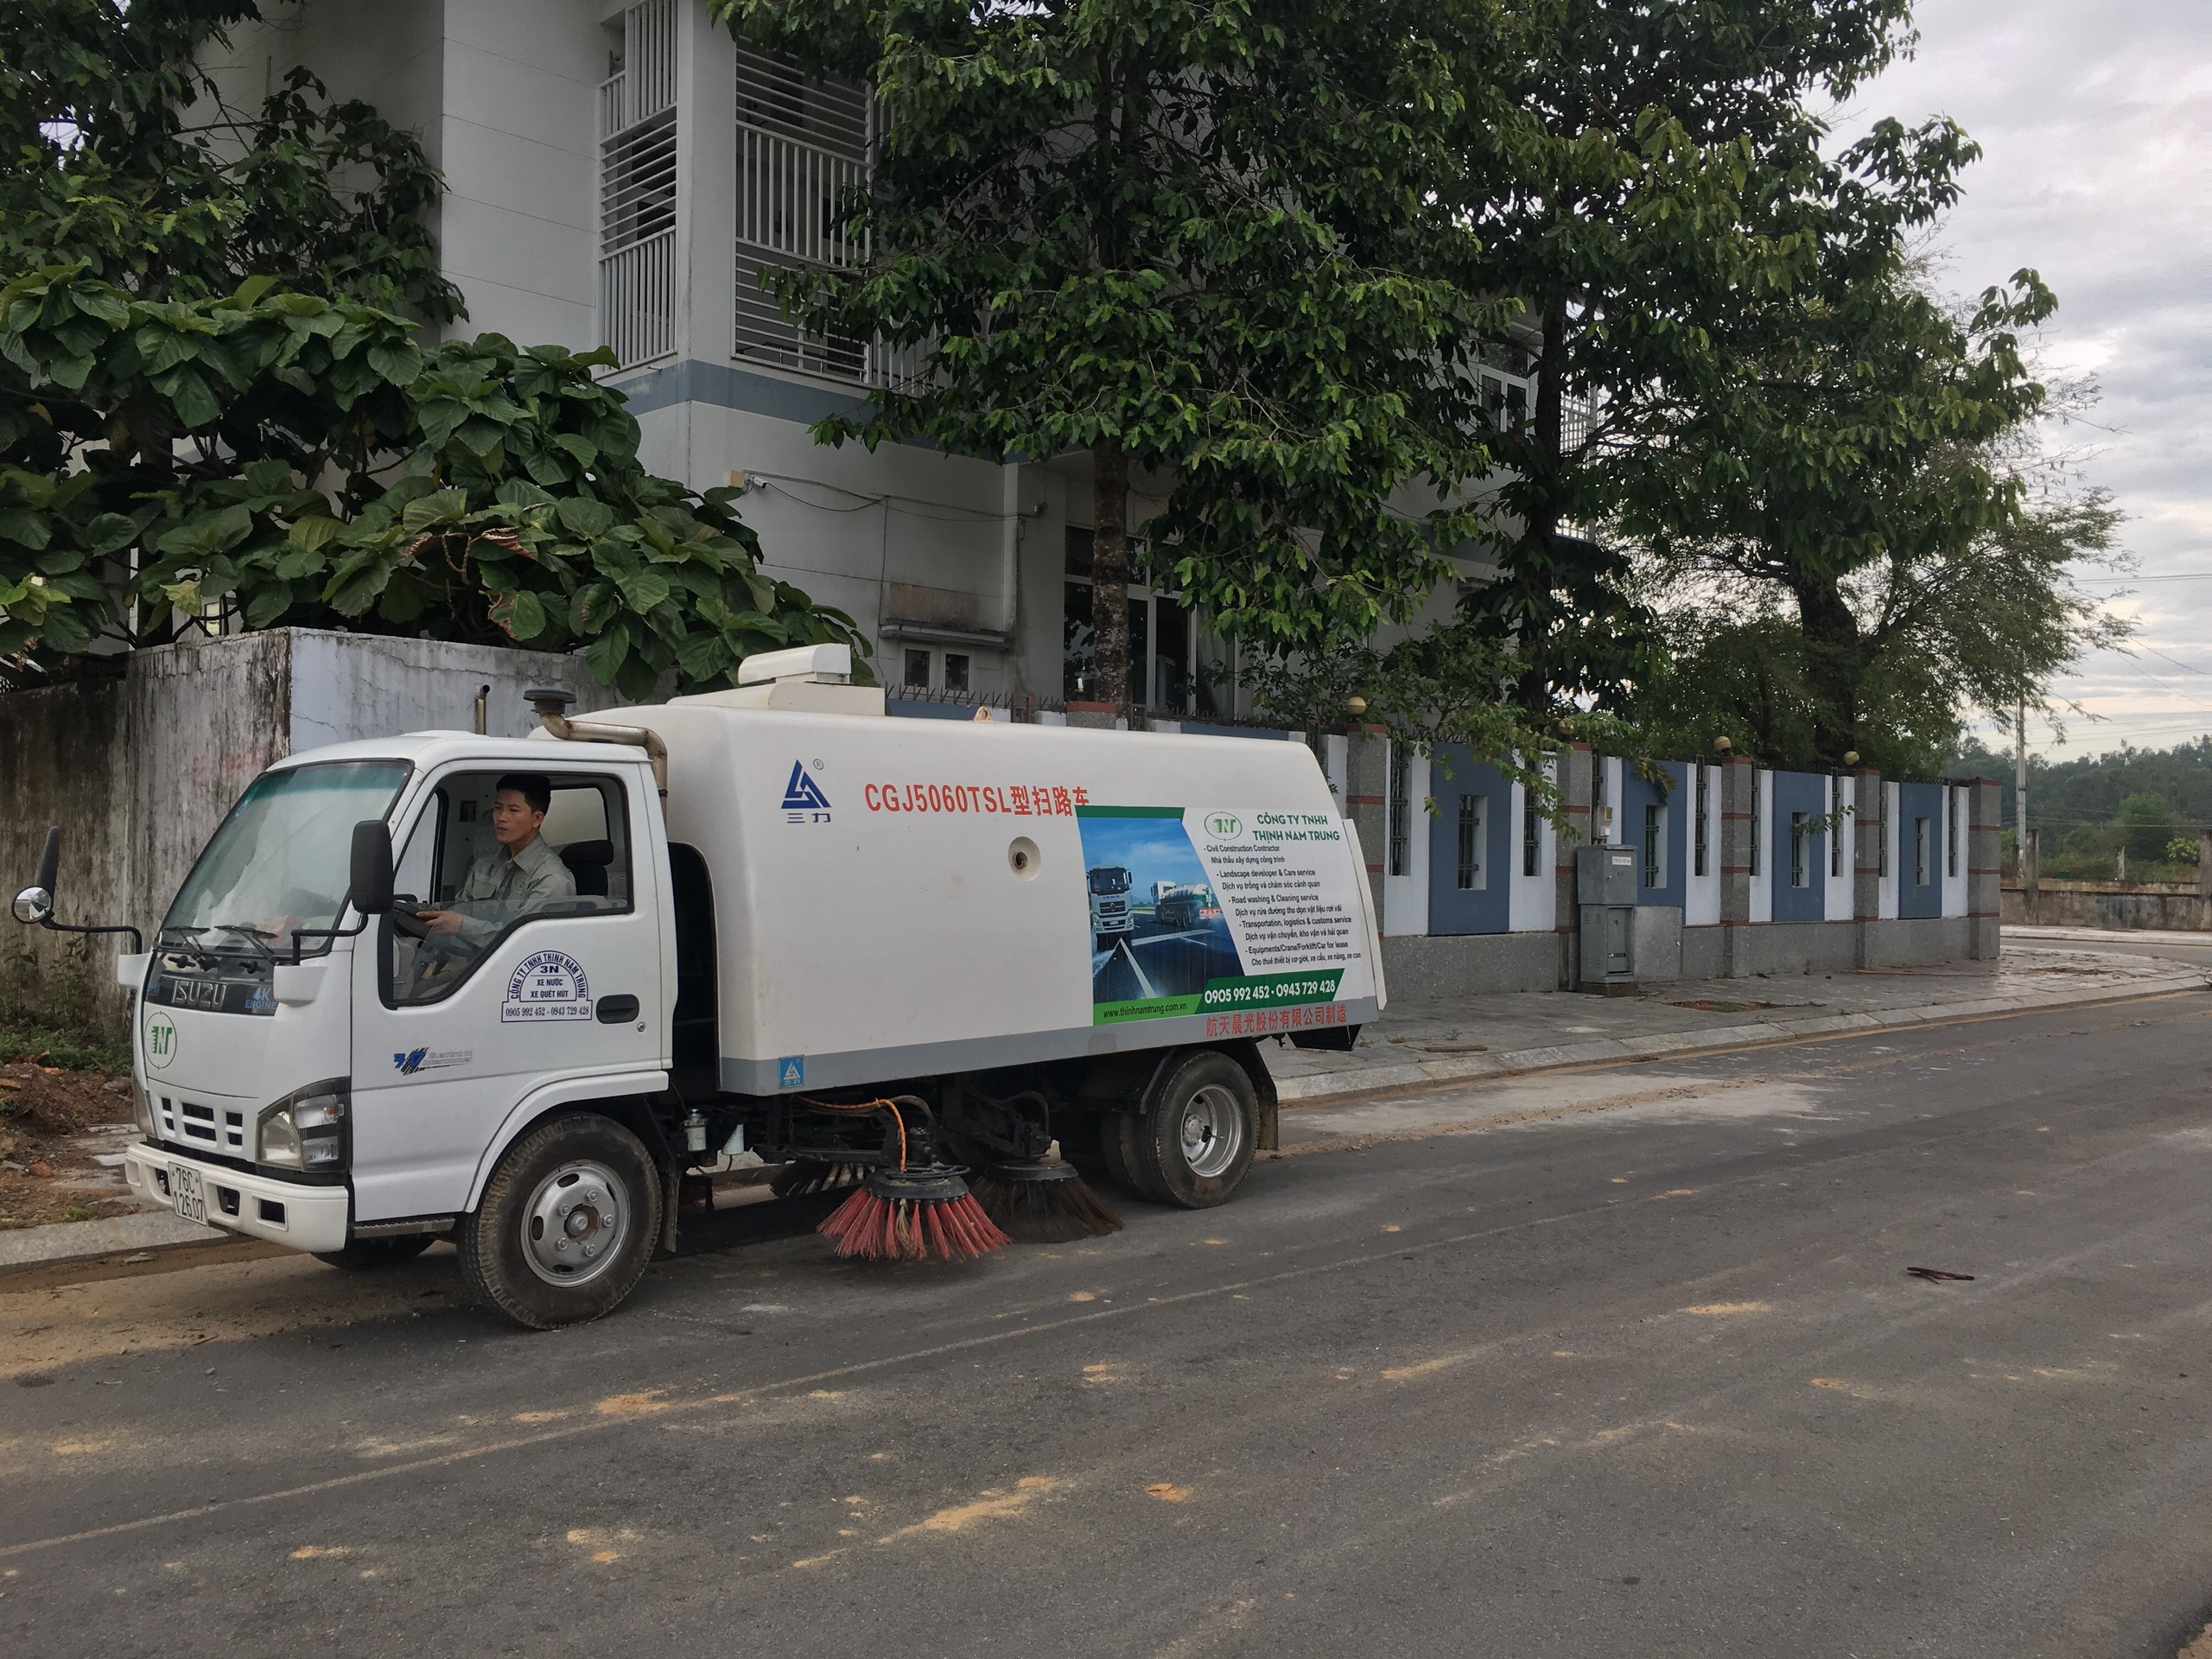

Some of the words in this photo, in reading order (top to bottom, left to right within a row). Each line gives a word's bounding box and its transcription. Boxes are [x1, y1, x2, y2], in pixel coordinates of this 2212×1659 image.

[1257, 812, 1286, 825] CÔNG
[1287, 815, 1299, 825] TY
[1301, 815, 1328, 825] TNHH
[1253, 830, 1283, 843] THỊNH
[1285, 830, 1307, 841] NAM
[1308, 830, 1340, 842] TRUNG
[1236, 856, 1244, 865] xây
[1245, 856, 1259, 865] dựng
[1260, 855, 1273, 865] công
[1219, 869, 1249, 879] Landscape
[1251, 869, 1277, 878] developer
[1222, 881, 1235, 891] Dịch
[1247, 895, 1270, 904] washing
[1276, 894, 1300, 903] Cleaning
[1236, 908, 1248, 918] Dịch
[1242, 918, 1283, 929] Transportation,
[1283, 918, 1306, 927] logistics
[517, 968, 527, 978] TY
[524, 954, 542, 970] TNHH
[564, 958, 579, 975] NAM
[575, 974, 586, 998] TRUNG
[539, 965, 559, 974] 3N
[171, 980, 226, 1010] ISUZU
[253, 988, 271, 1001] 4K
[1205, 988, 1231, 1003] 0905
[1234, 988, 1250, 1001] 992
[1253, 985, 1269, 1000] 452
[1276, 982, 1300, 997] 0943
[1302, 981, 1318, 995] 729
[1319, 980, 1335, 993] 428
[245, 999, 277, 1009] ENGINE
[1103, 1002, 1187, 1018] www.thinhnamtrung.com.vn
[505, 1007, 520, 1017] 0905
[522, 1007, 533, 1016] 992
[534, 1007, 545, 1016] 452
[550, 1007, 565, 1015] 0943
[567, 1007, 577, 1015] 729
[579, 1006, 589, 1015] 428
[1206, 1004, 1346, 1037] 航天晨光股份有限公司制造
[175, 1166, 194, 1194] 76C
[174, 1191, 203, 1222] 126.07
